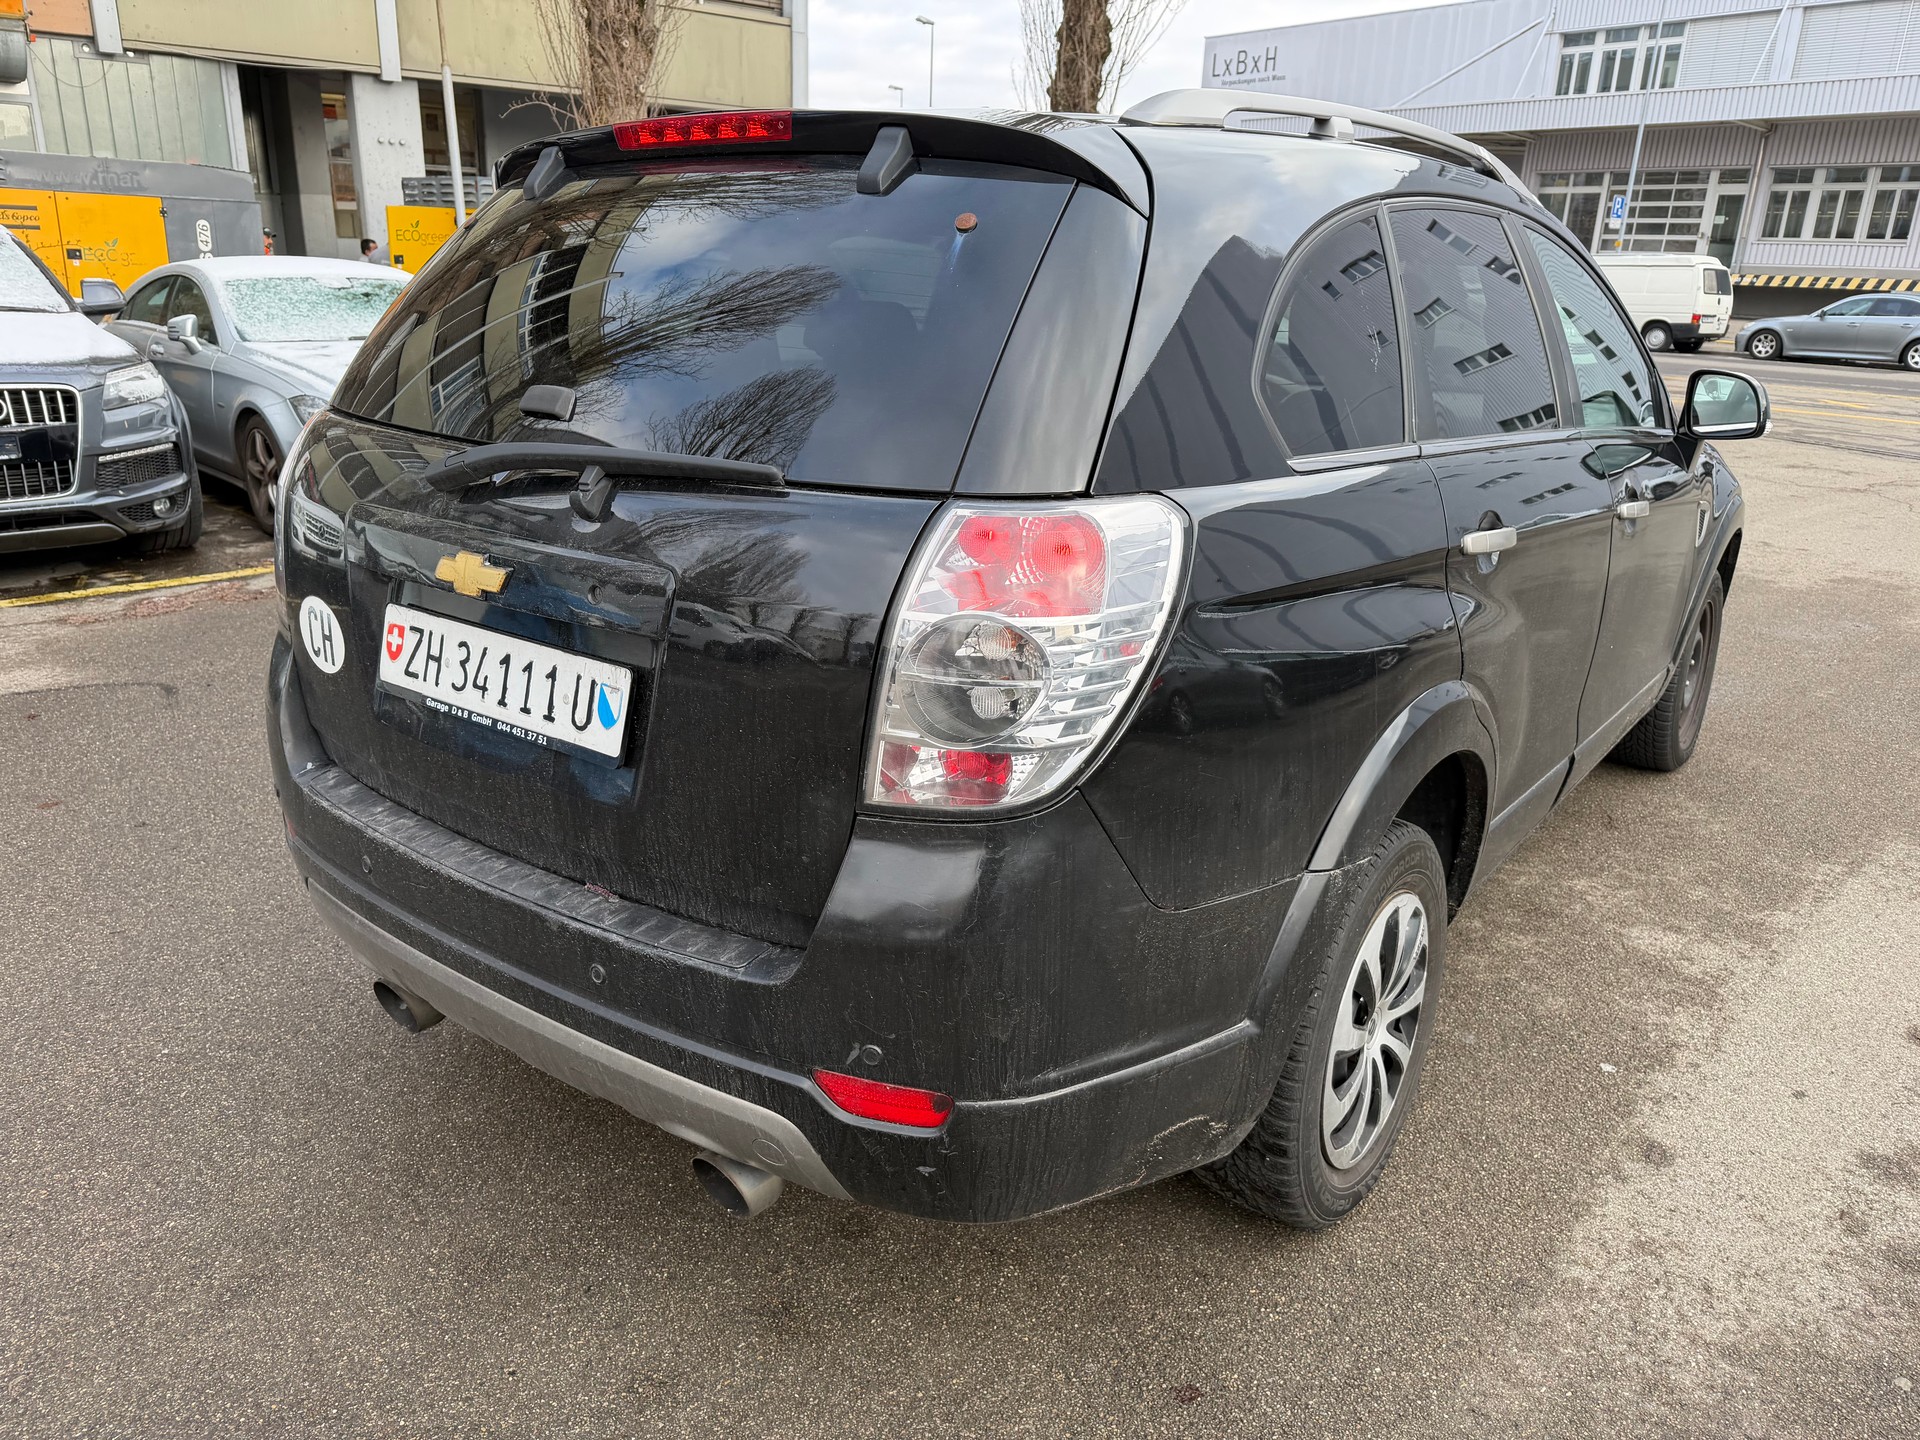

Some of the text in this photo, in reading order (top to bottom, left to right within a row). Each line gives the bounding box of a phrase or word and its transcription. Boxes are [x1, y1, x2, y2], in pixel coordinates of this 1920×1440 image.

[1212, 46, 1277, 77] LxBxH
[198, 223, 210, 247] 476
[307, 606, 336, 667] CH
[404, 626, 598, 732] ZH 34111 U
[426, 697, 449, 712] Garage
[471, 713, 492, 726] GmbH
[497, 721, 511, 733] 044
[511, 726, 525, 738] 451
[526, 731, 537, 741] 37
[538, 735, 547, 745] 51
